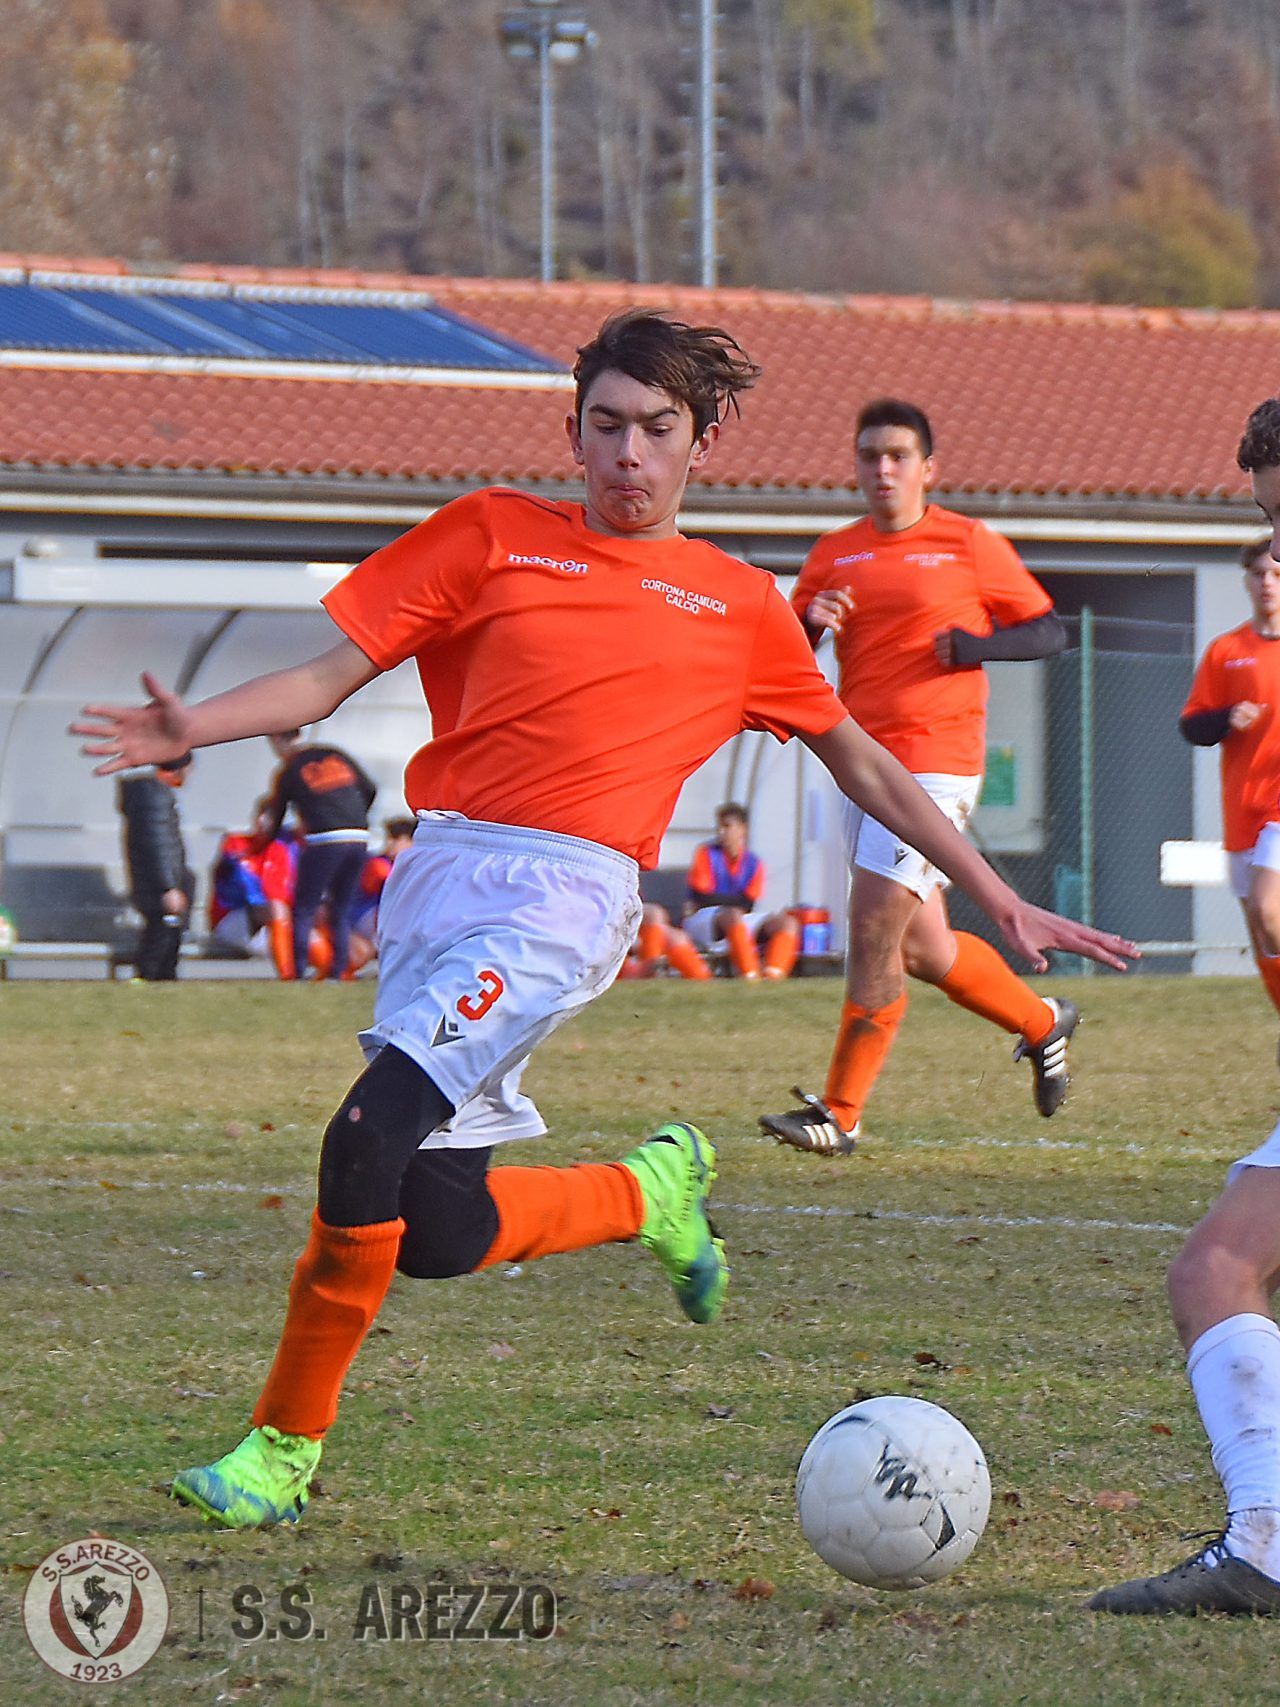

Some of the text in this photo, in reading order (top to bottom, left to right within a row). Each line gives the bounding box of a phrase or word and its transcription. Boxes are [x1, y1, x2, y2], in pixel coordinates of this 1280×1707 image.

[508, 552, 588, 574] macron
[641, 578, 727, 615] CORTONA CAMUCIA
[665, 593, 700, 615] CALCIO
[456, 970, 504, 1021] 3
